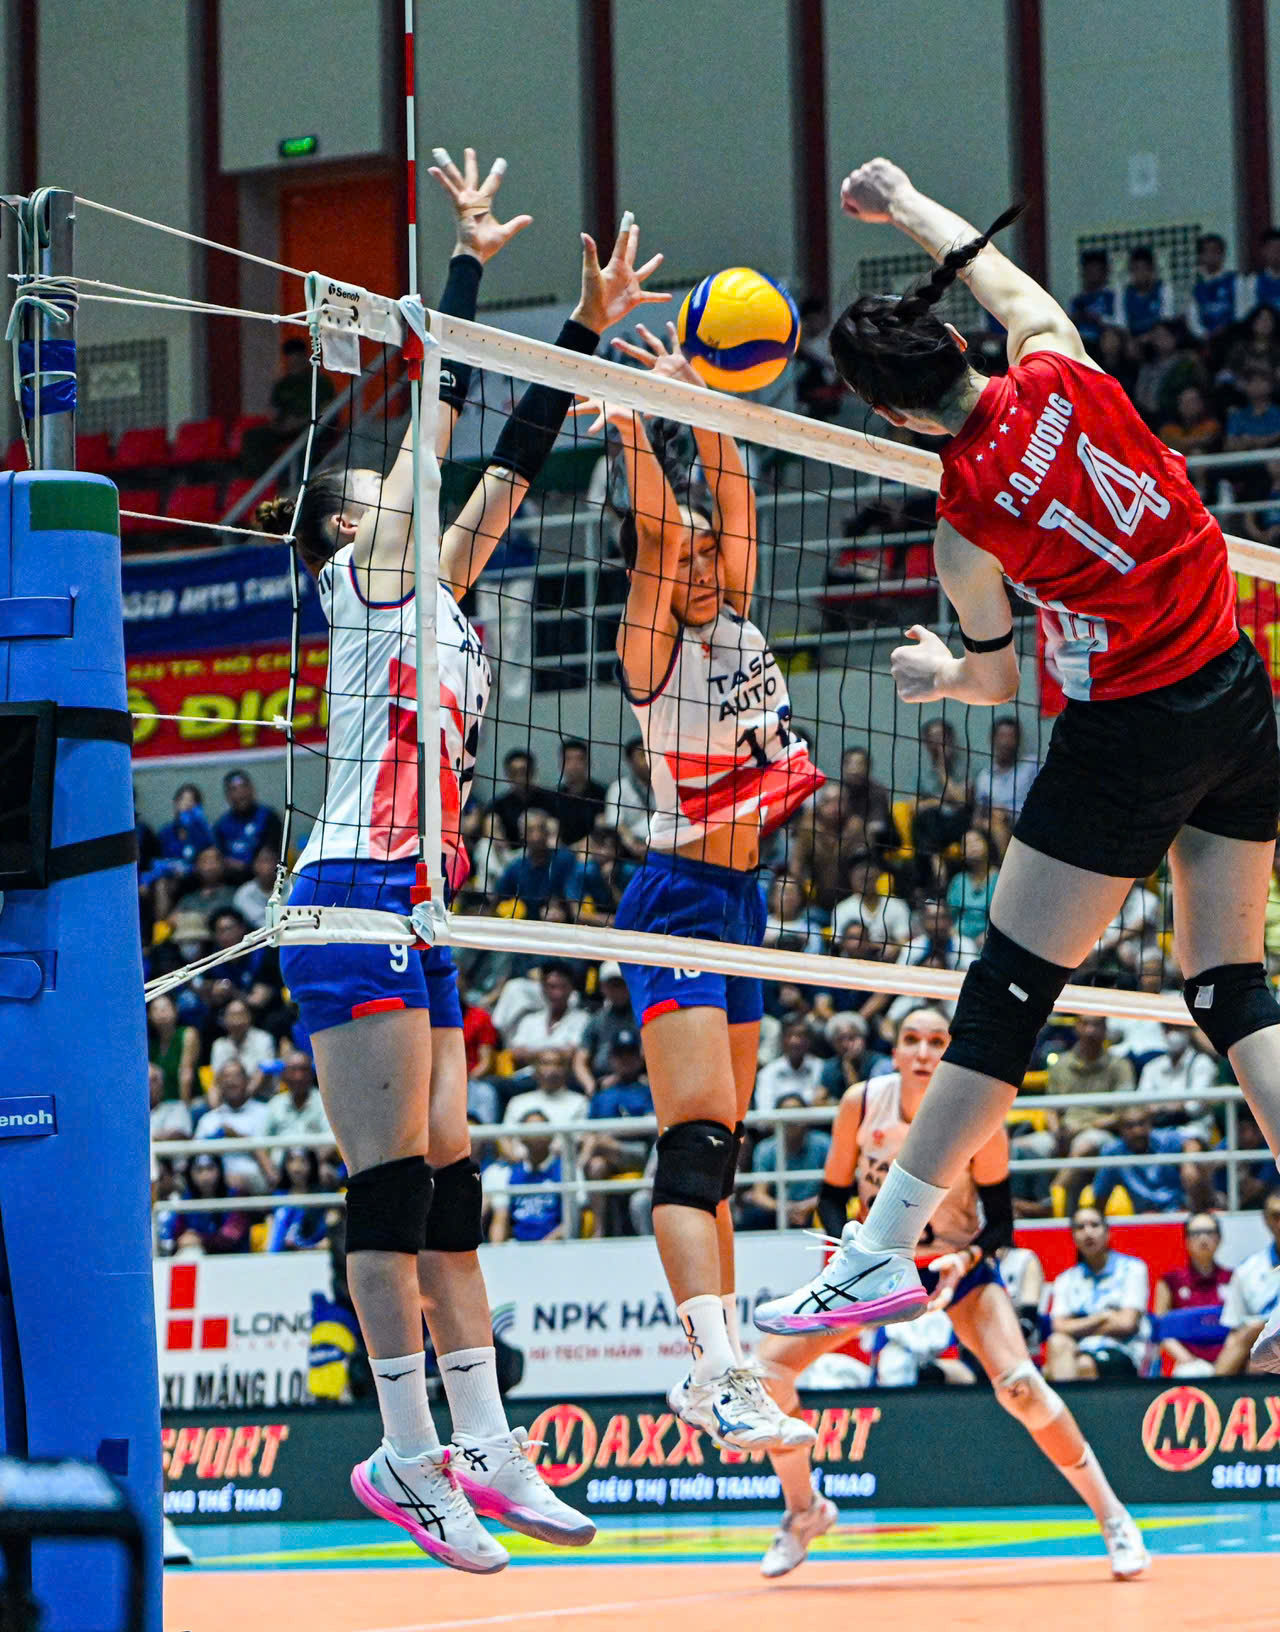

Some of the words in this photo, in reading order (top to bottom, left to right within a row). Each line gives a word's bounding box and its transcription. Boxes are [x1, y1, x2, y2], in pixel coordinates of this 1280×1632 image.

[336, 287, 360, 302] Senoh
[994, 393, 1073, 518] P.Q.HƯƠNG
[1037, 432, 1171, 575] 14
[719, 677, 777, 722] AUTO
[389, 944, 408, 973] 9
[532, 1304, 608, 1332] NPK
[620, 1293, 682, 1330] HÀ
[276, 1370, 309, 1405] LO
